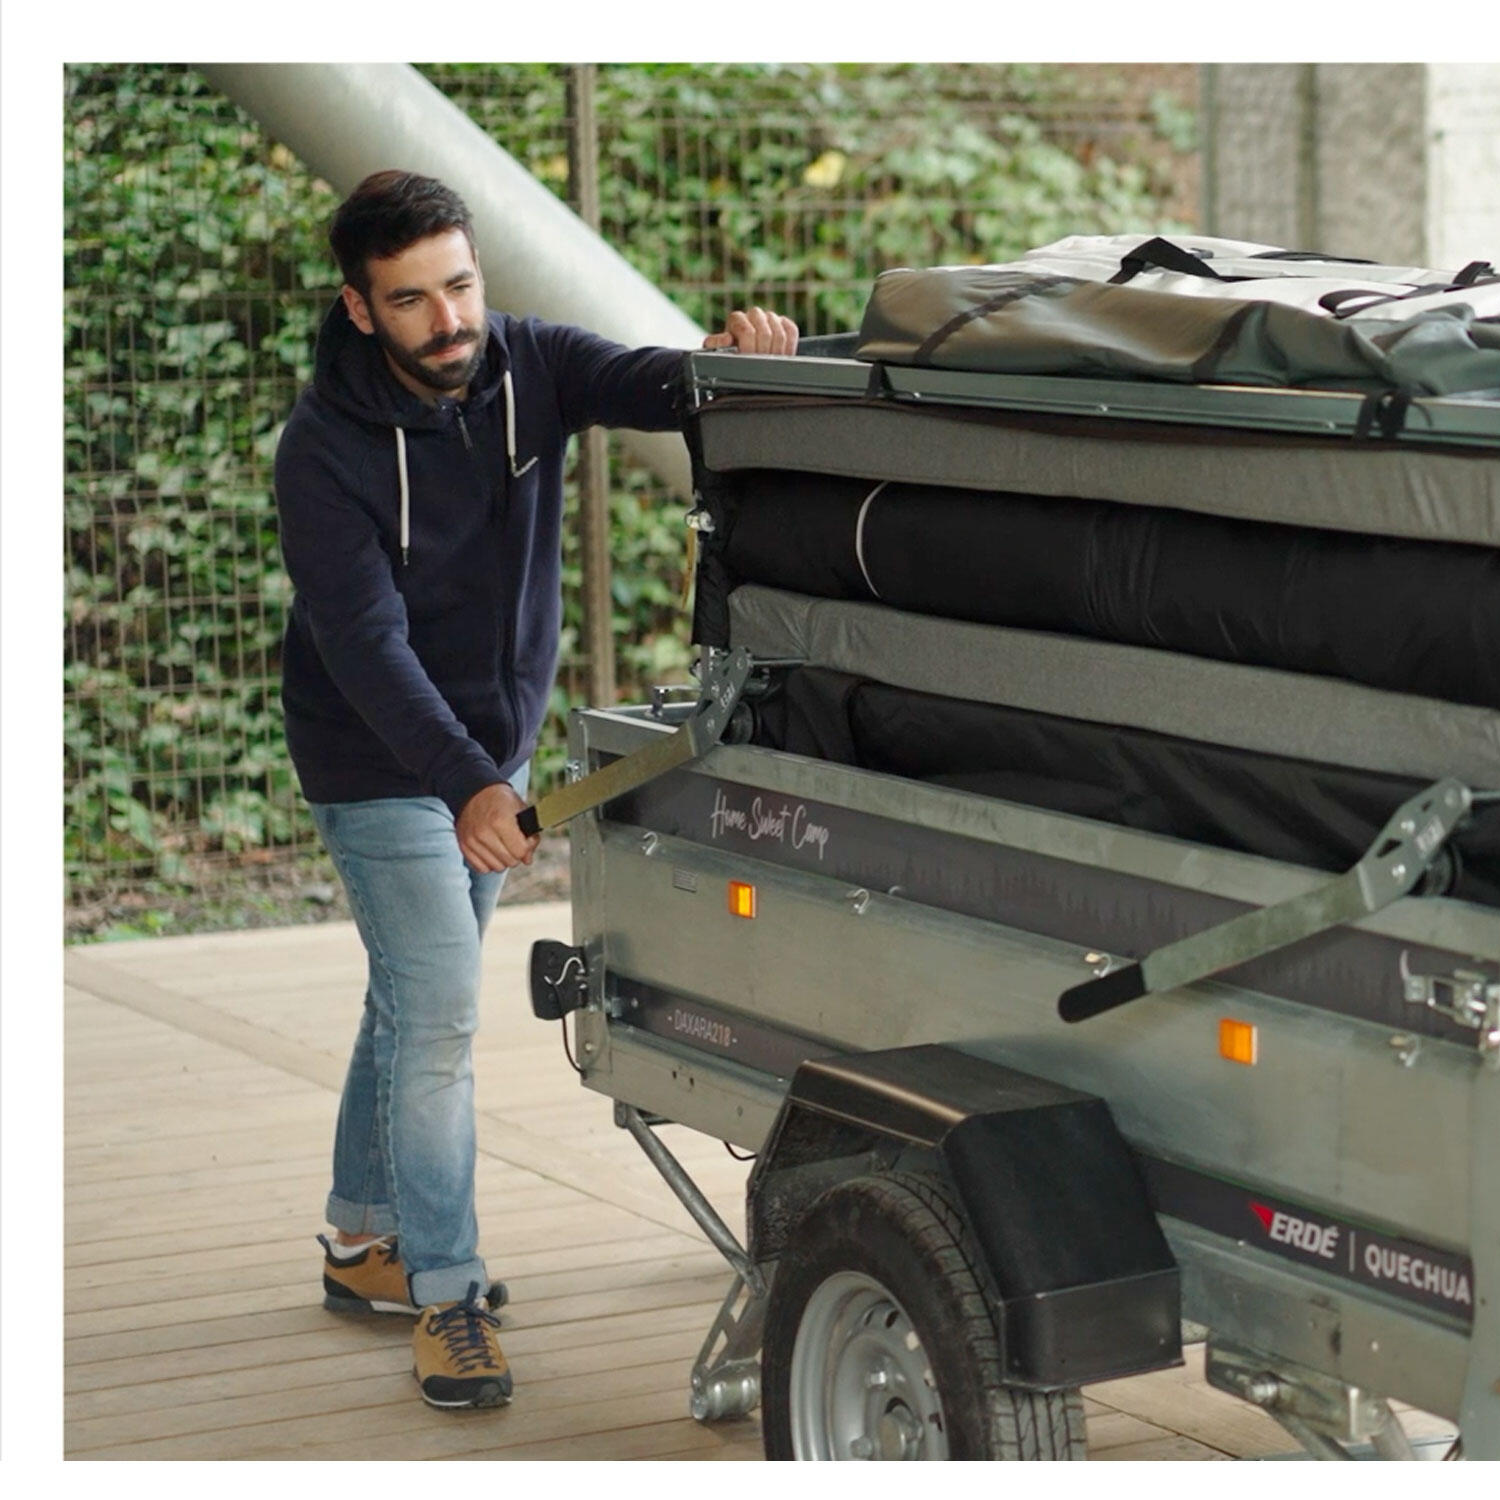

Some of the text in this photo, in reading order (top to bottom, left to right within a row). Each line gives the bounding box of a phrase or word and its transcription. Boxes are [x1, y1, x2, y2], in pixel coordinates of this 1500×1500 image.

[711, 788, 829, 861] Home Sweet Camp
[1364, 1243, 1471, 1305] QUECHUA
